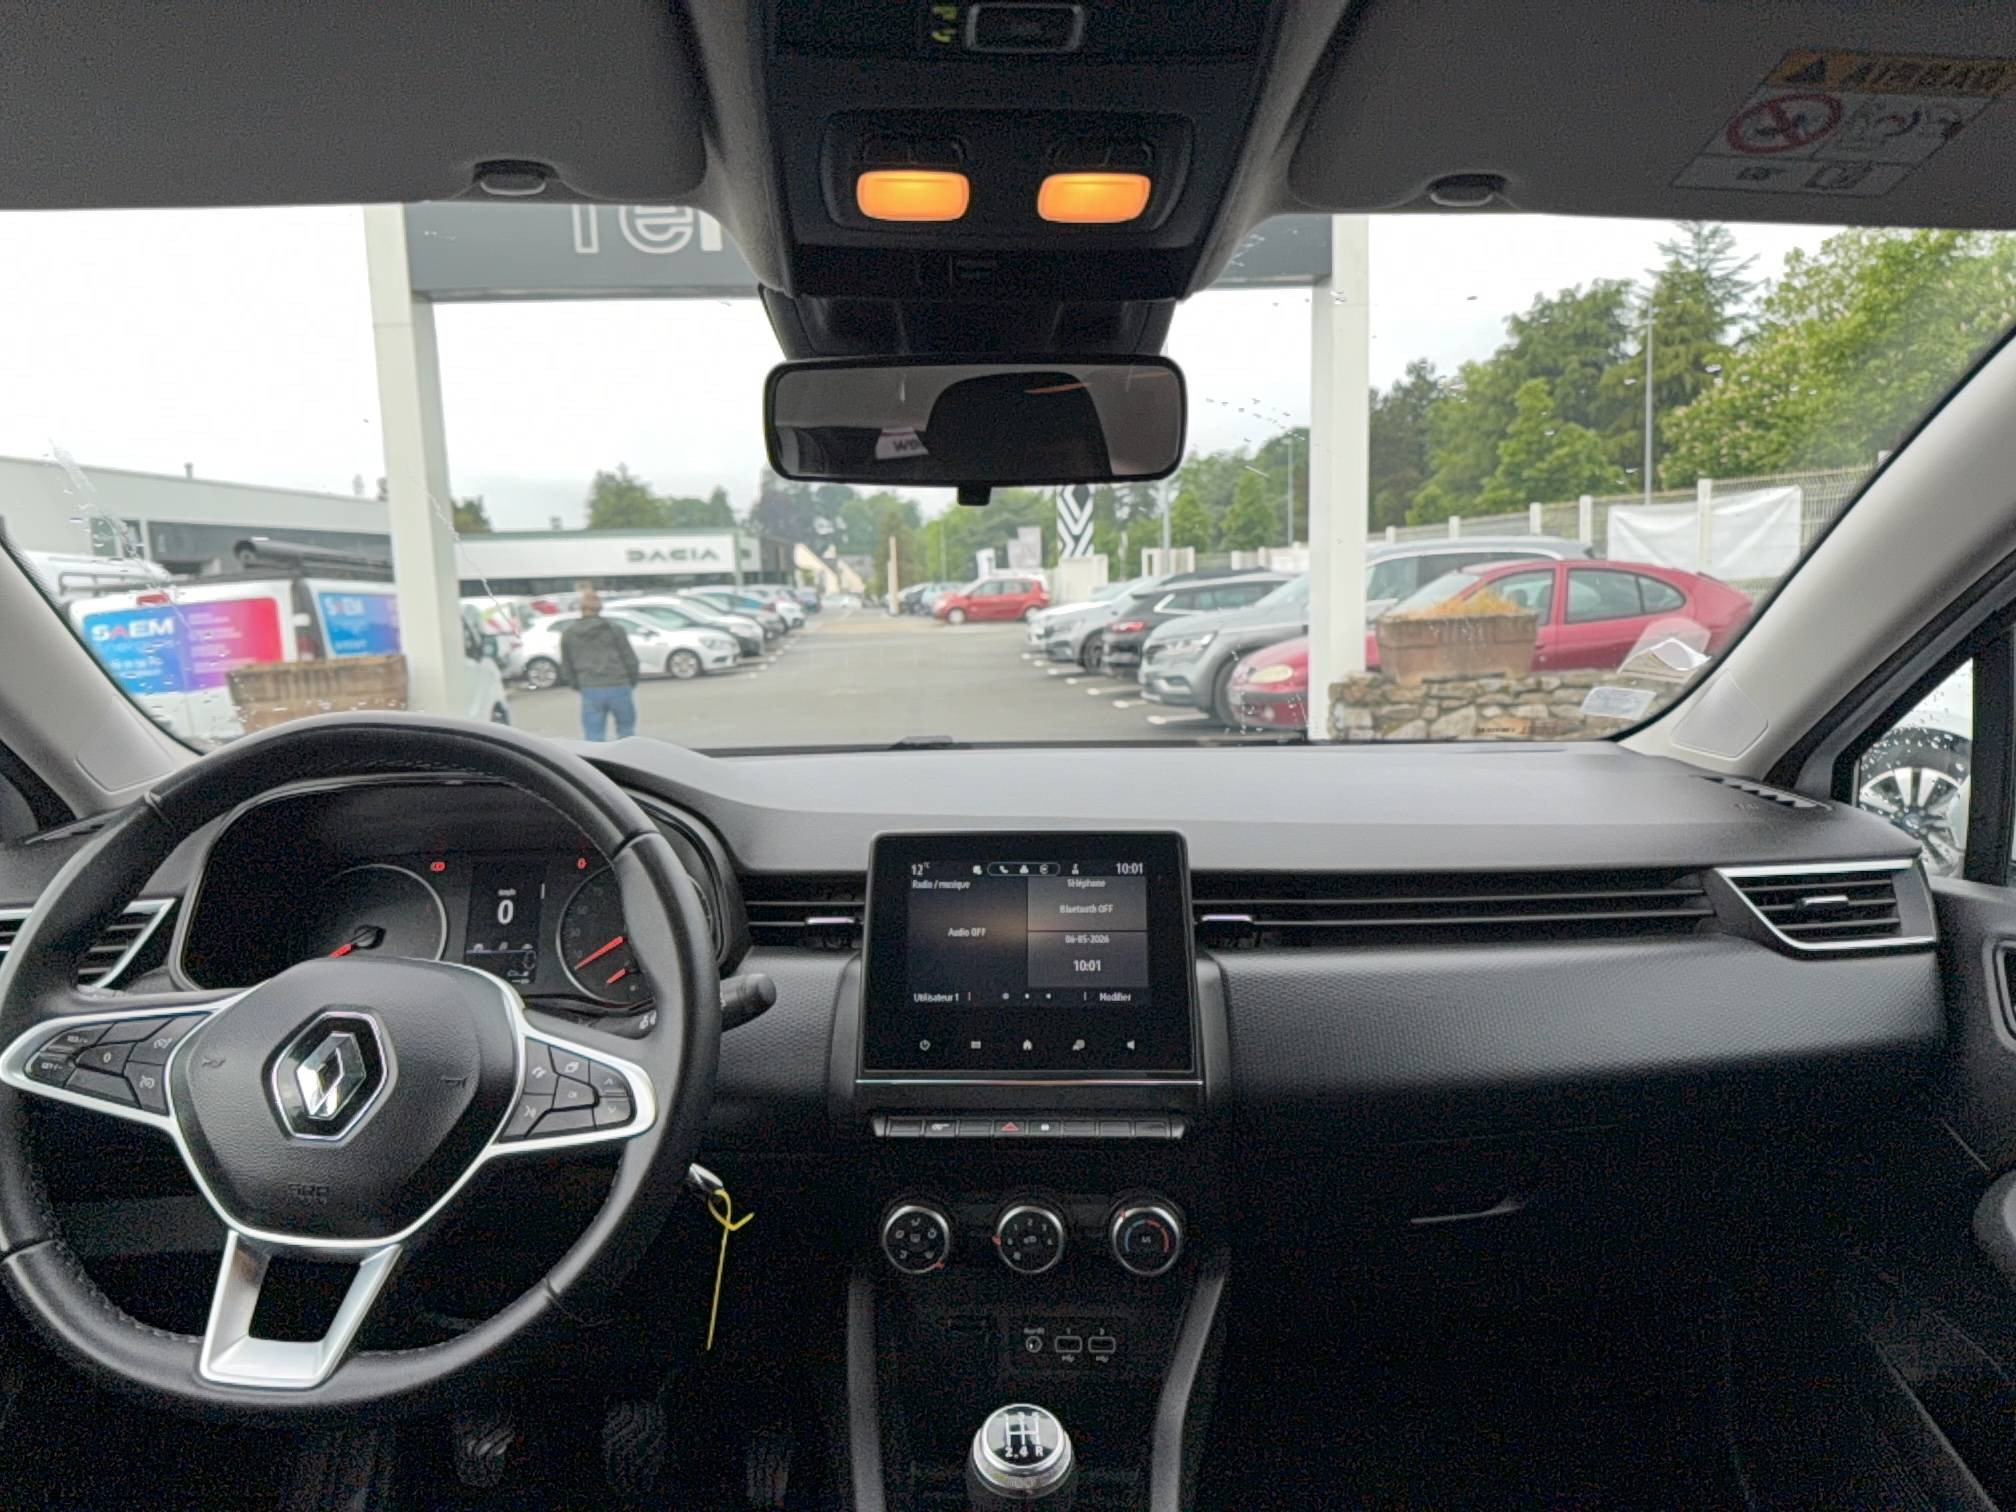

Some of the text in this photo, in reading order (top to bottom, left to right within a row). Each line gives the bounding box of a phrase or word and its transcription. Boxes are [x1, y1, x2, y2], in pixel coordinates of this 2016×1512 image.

[626, 547, 720, 564] DACIA
[91, 617, 176, 642] SAEM
[1116, 862, 1144, 875] 10:01
[1059, 904, 1114, 914] Bluetooth OFF
[947, 927, 986, 937] Audio OFF
[1073, 959, 1102, 972] 10:01
[913, 992, 954, 1003] Utilisateur
[1099, 991, 1132, 1002] Modifier
[1005, 1446, 1014, 1458] 2
[1019, 1445, 1029, 1458] 4
[1035, 1446, 1044, 1457] R
